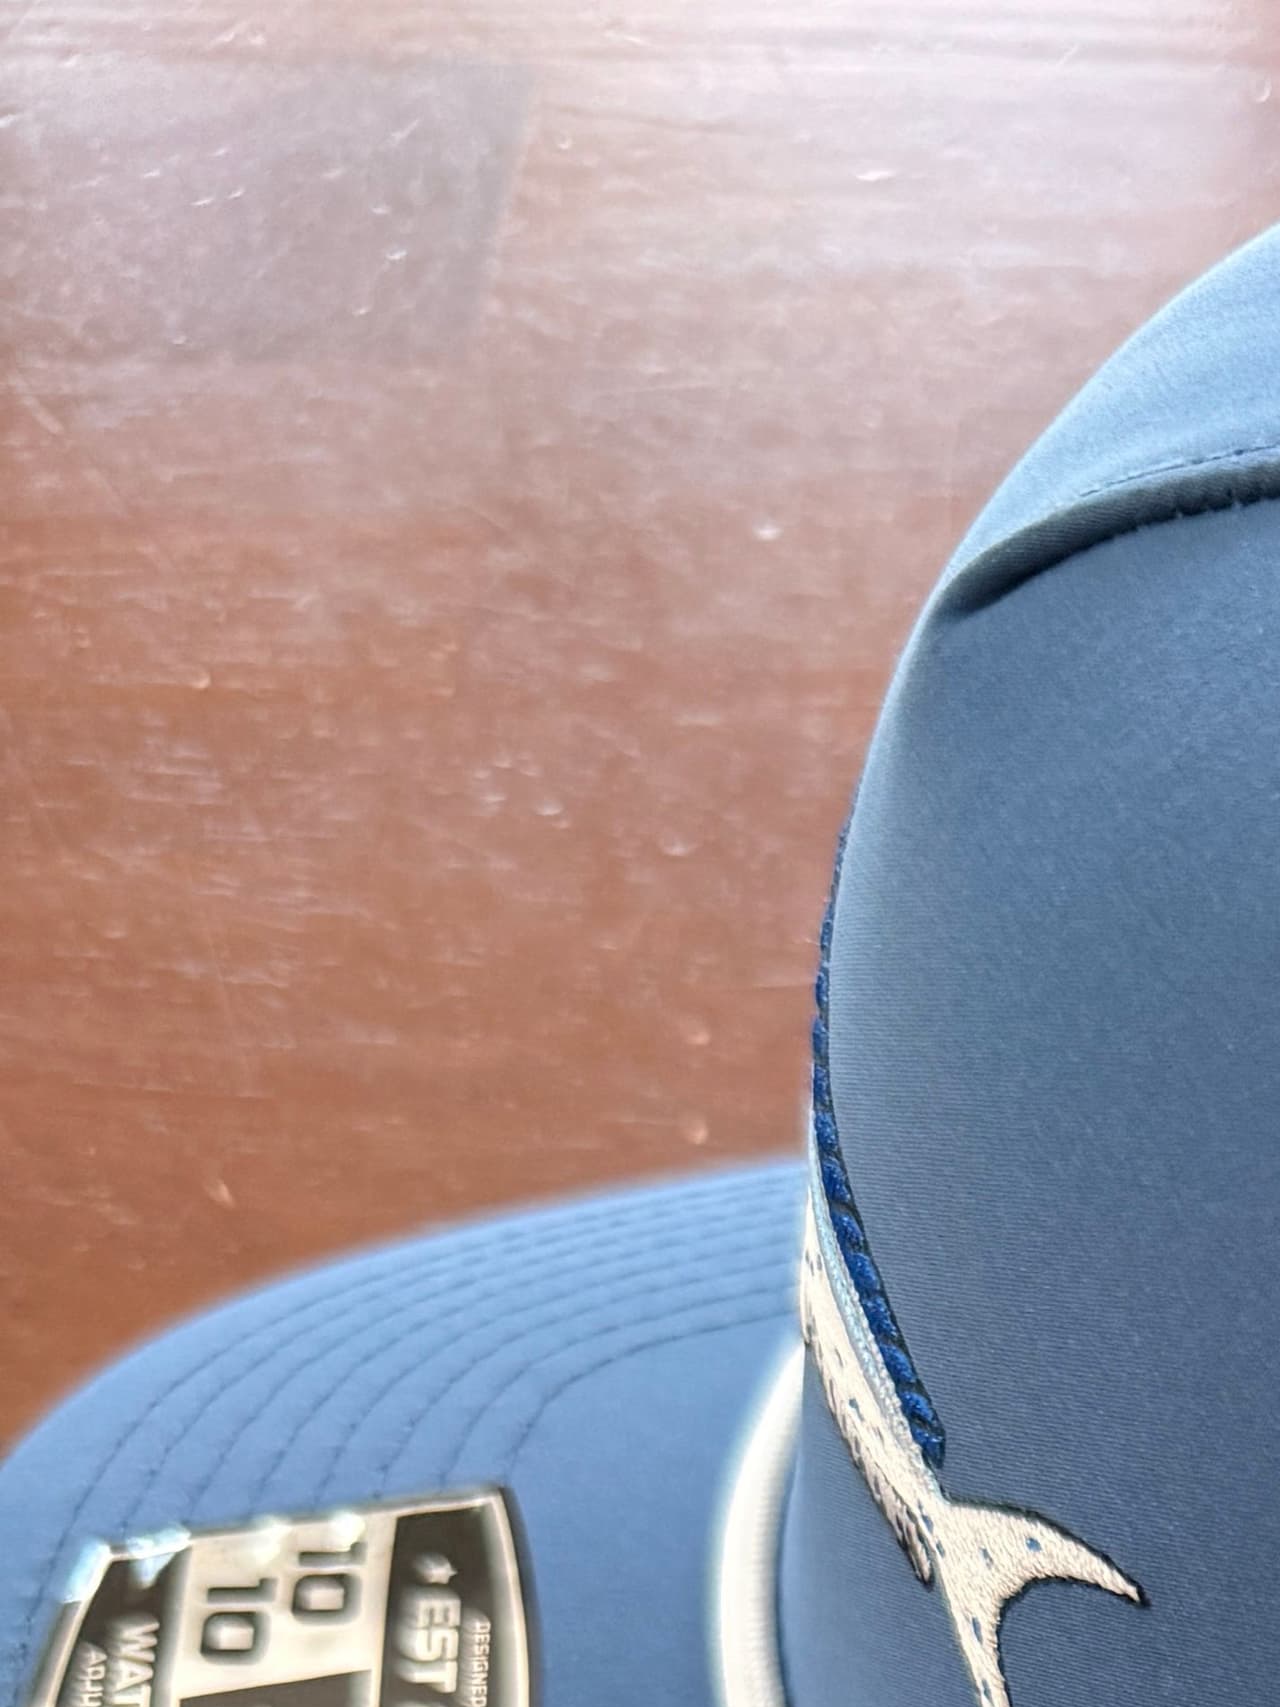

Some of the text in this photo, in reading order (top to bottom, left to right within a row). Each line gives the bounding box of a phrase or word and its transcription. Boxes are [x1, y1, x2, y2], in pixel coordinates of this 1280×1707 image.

[199, 1576, 278, 1665] 10
[290, 1541, 368, 1627] 10
[413, 1597, 461, 1693] EST
[468, 1621, 492, 1707] DESIGNED
